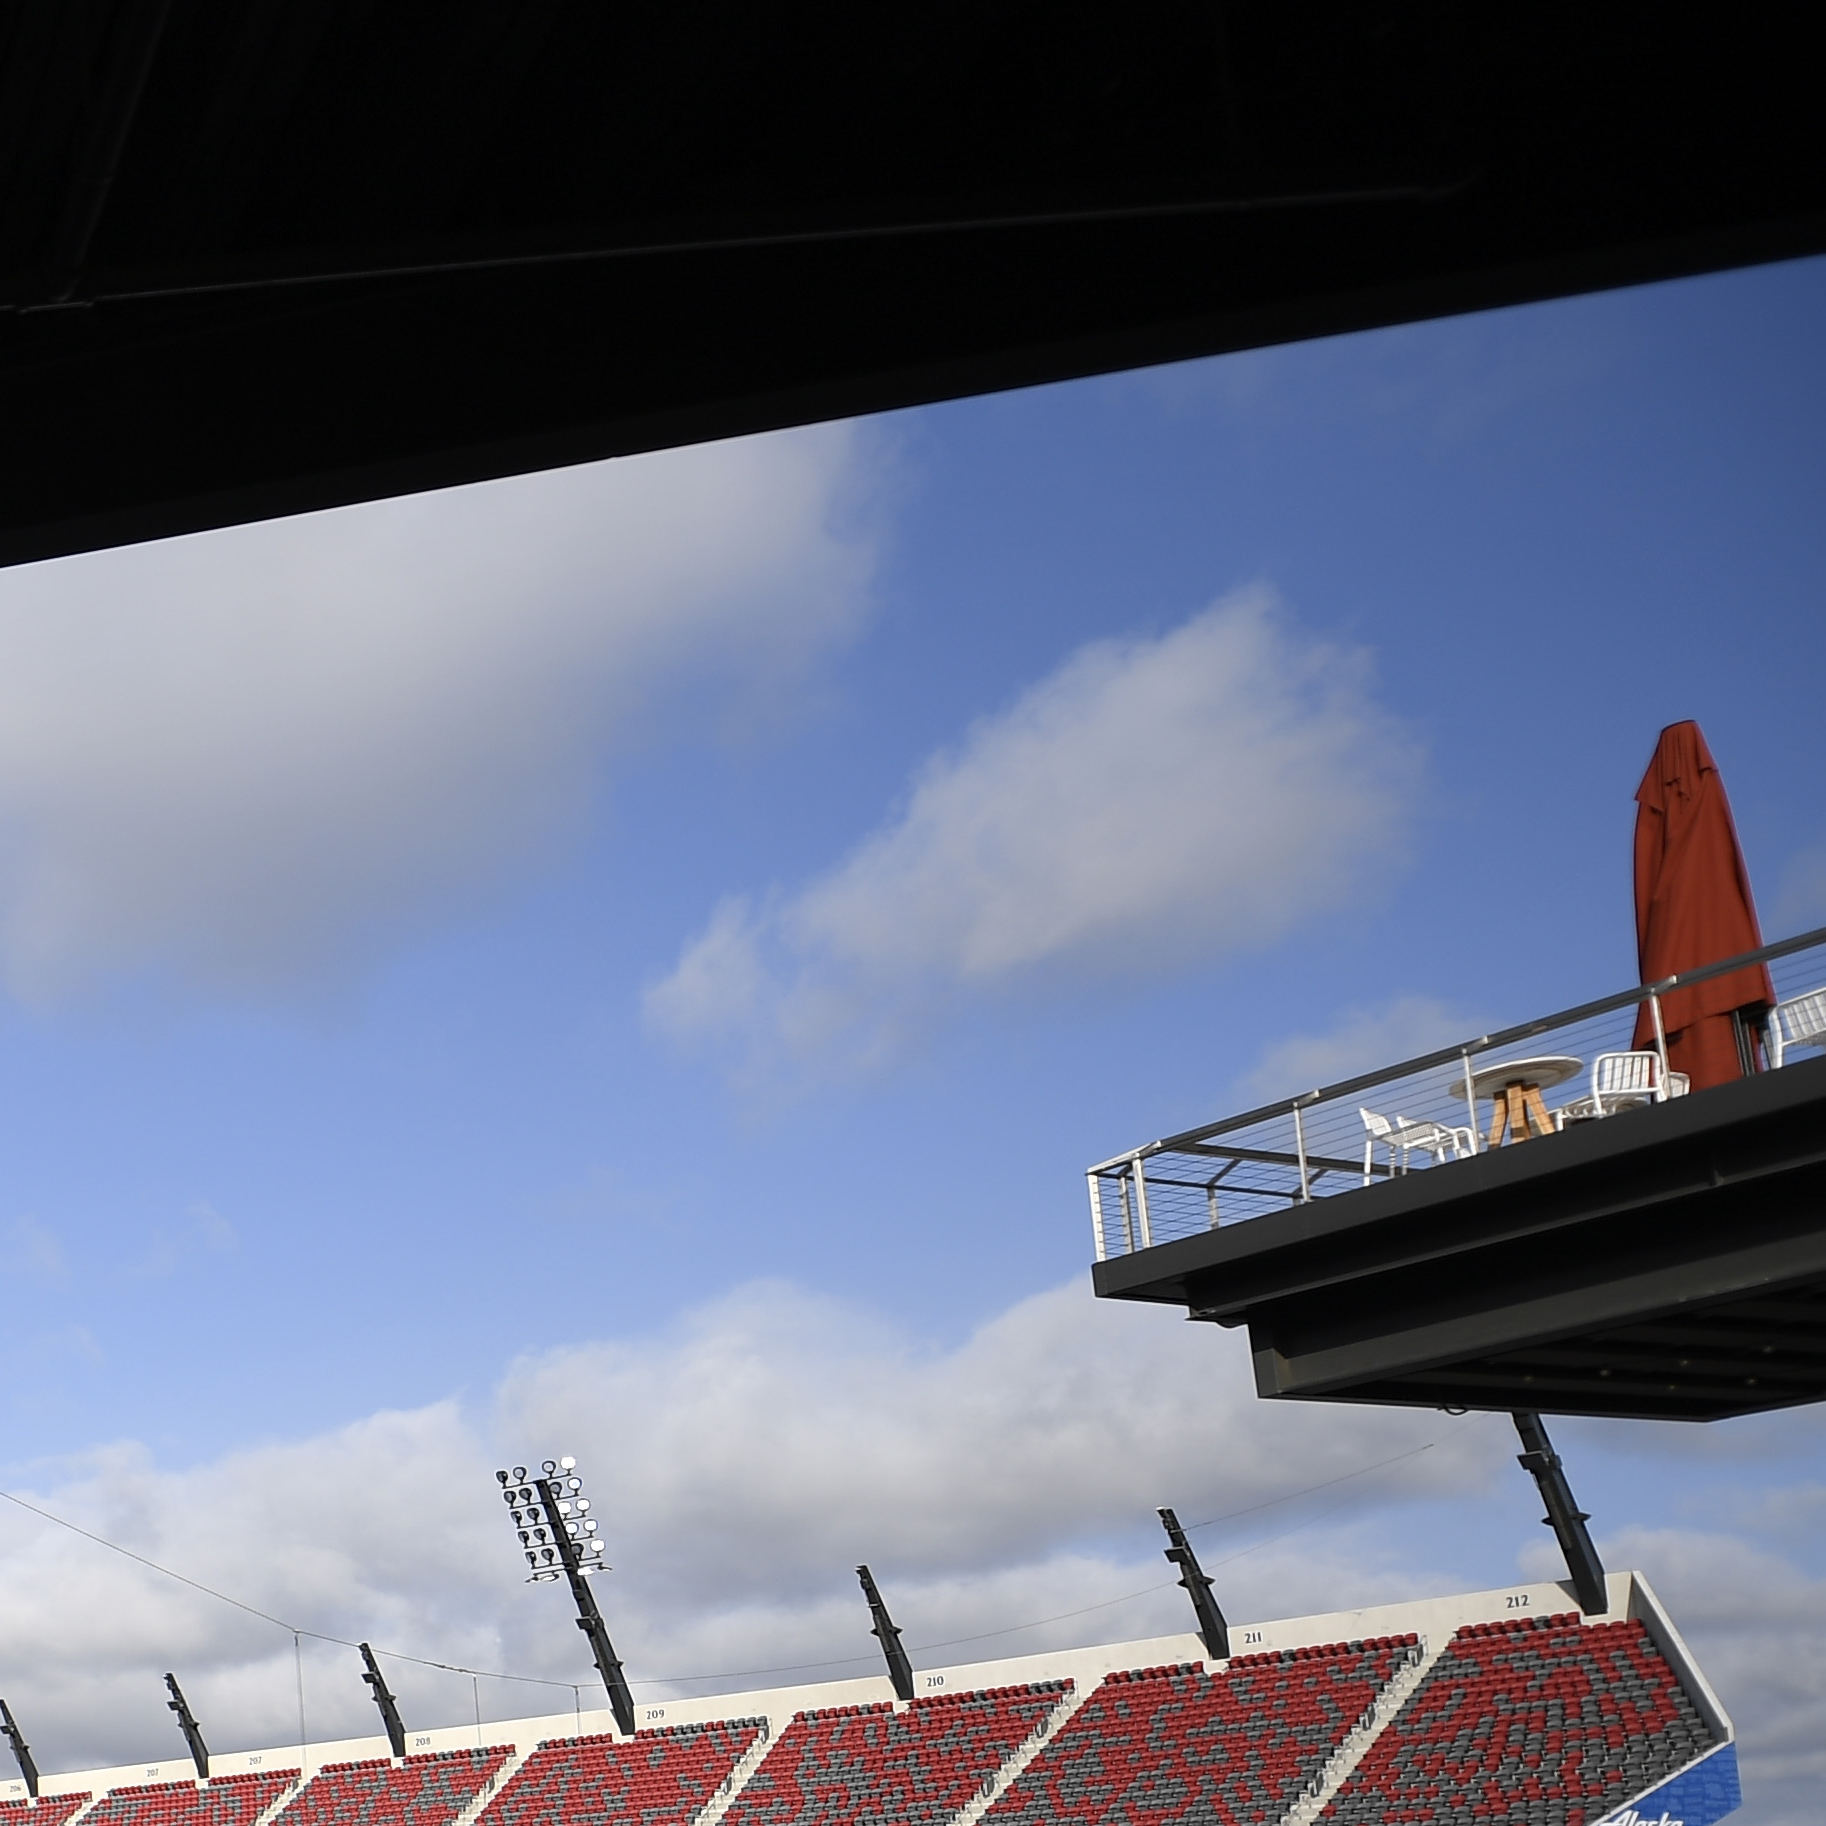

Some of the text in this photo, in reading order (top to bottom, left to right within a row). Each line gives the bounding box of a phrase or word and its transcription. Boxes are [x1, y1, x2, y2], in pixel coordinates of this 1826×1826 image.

[1506, 1595, 1530, 1608] 212
[1244, 1632, 1262, 1644] 211
[926, 1675, 944, 1687] 210
[646, 1709, 665, 1720] 209
[416, 1737, 431, 1747] 208
